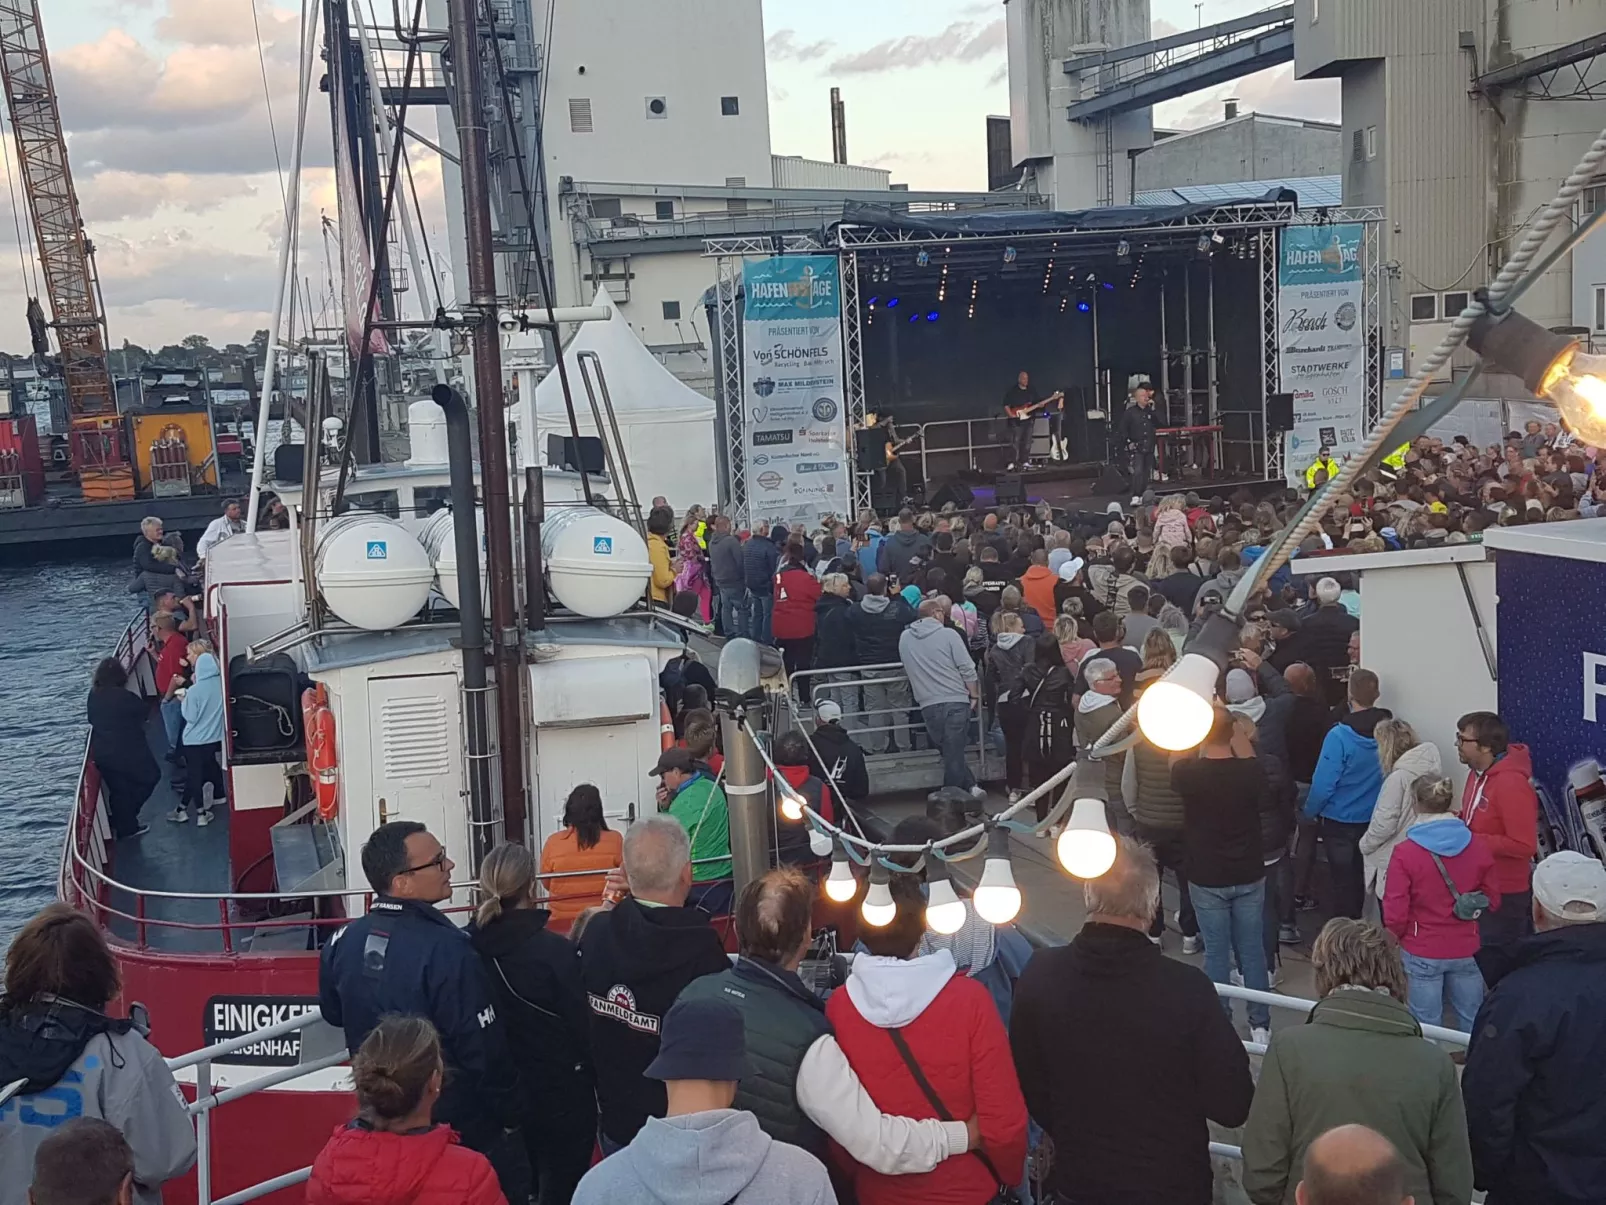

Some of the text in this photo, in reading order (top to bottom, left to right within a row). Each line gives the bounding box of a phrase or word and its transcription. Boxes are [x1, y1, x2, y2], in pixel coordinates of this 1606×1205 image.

[1286, 250, 1321, 265] HAFEN
[752, 282, 788, 298] HAFEN
[1300, 289, 1337, 299] PRÄSENTIERT
[768, 327, 808, 336] PRÄSENTIERT
[752, 346, 829, 360] Von SCHÖNFELS
[1291, 361, 1350, 374] STADTWERKE
[1322, 386, 1348, 396] GOSCH
[757, 432, 790, 442] TAMATSU
[215, 1037, 300, 1056] GENHAF
